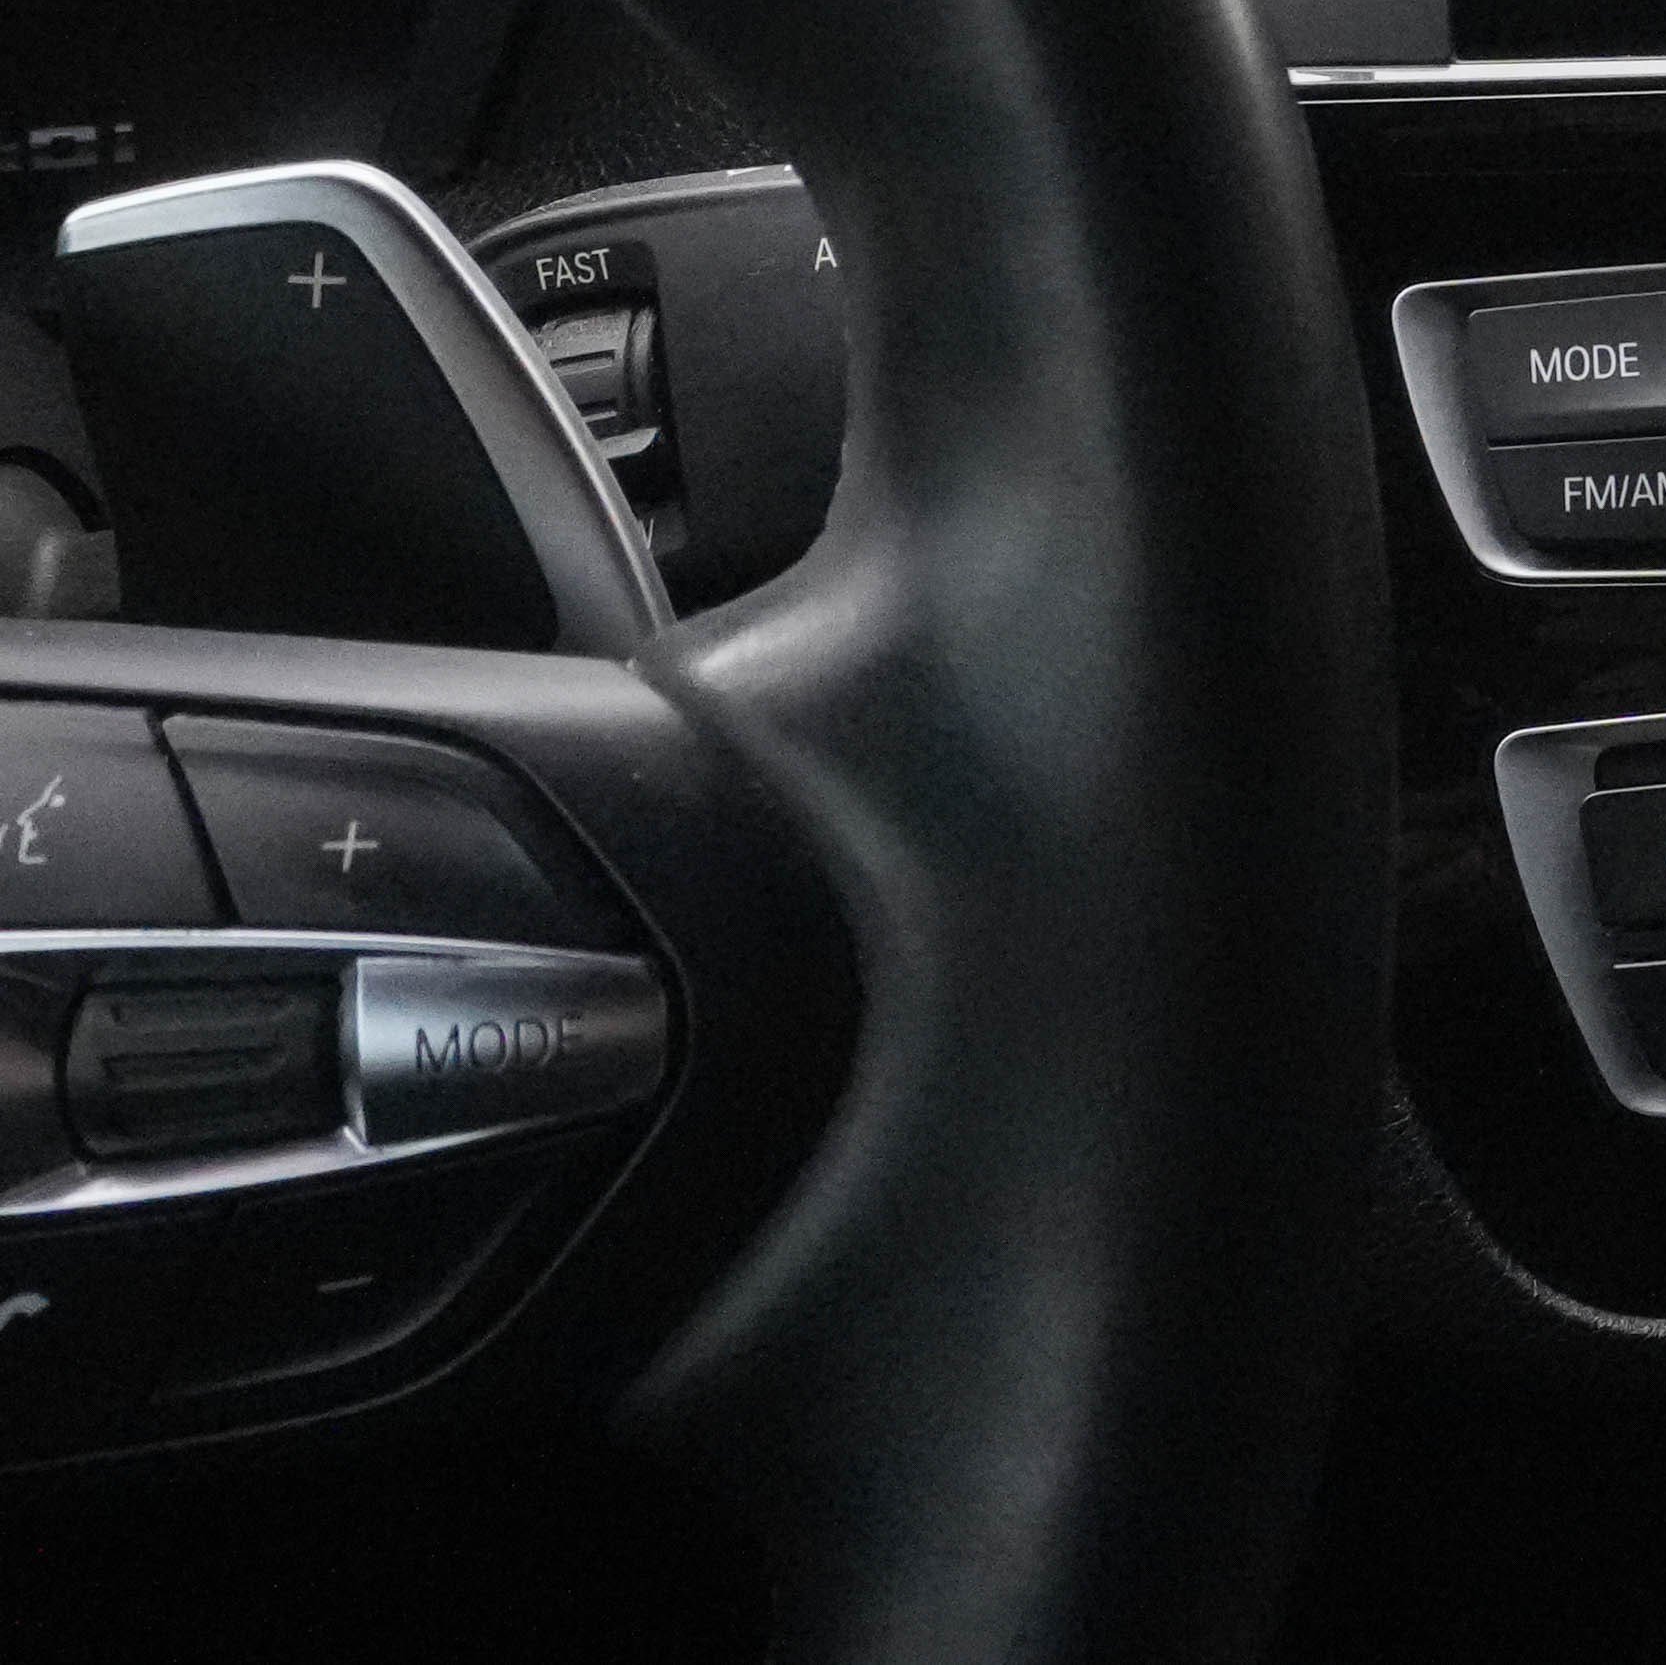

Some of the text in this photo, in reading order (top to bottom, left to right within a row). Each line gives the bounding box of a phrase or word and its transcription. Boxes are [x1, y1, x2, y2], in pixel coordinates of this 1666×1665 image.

[536, 248, 609, 290] FAST
[815, 237, 837, 270] A
[1531, 343, 1639, 383] MODE
